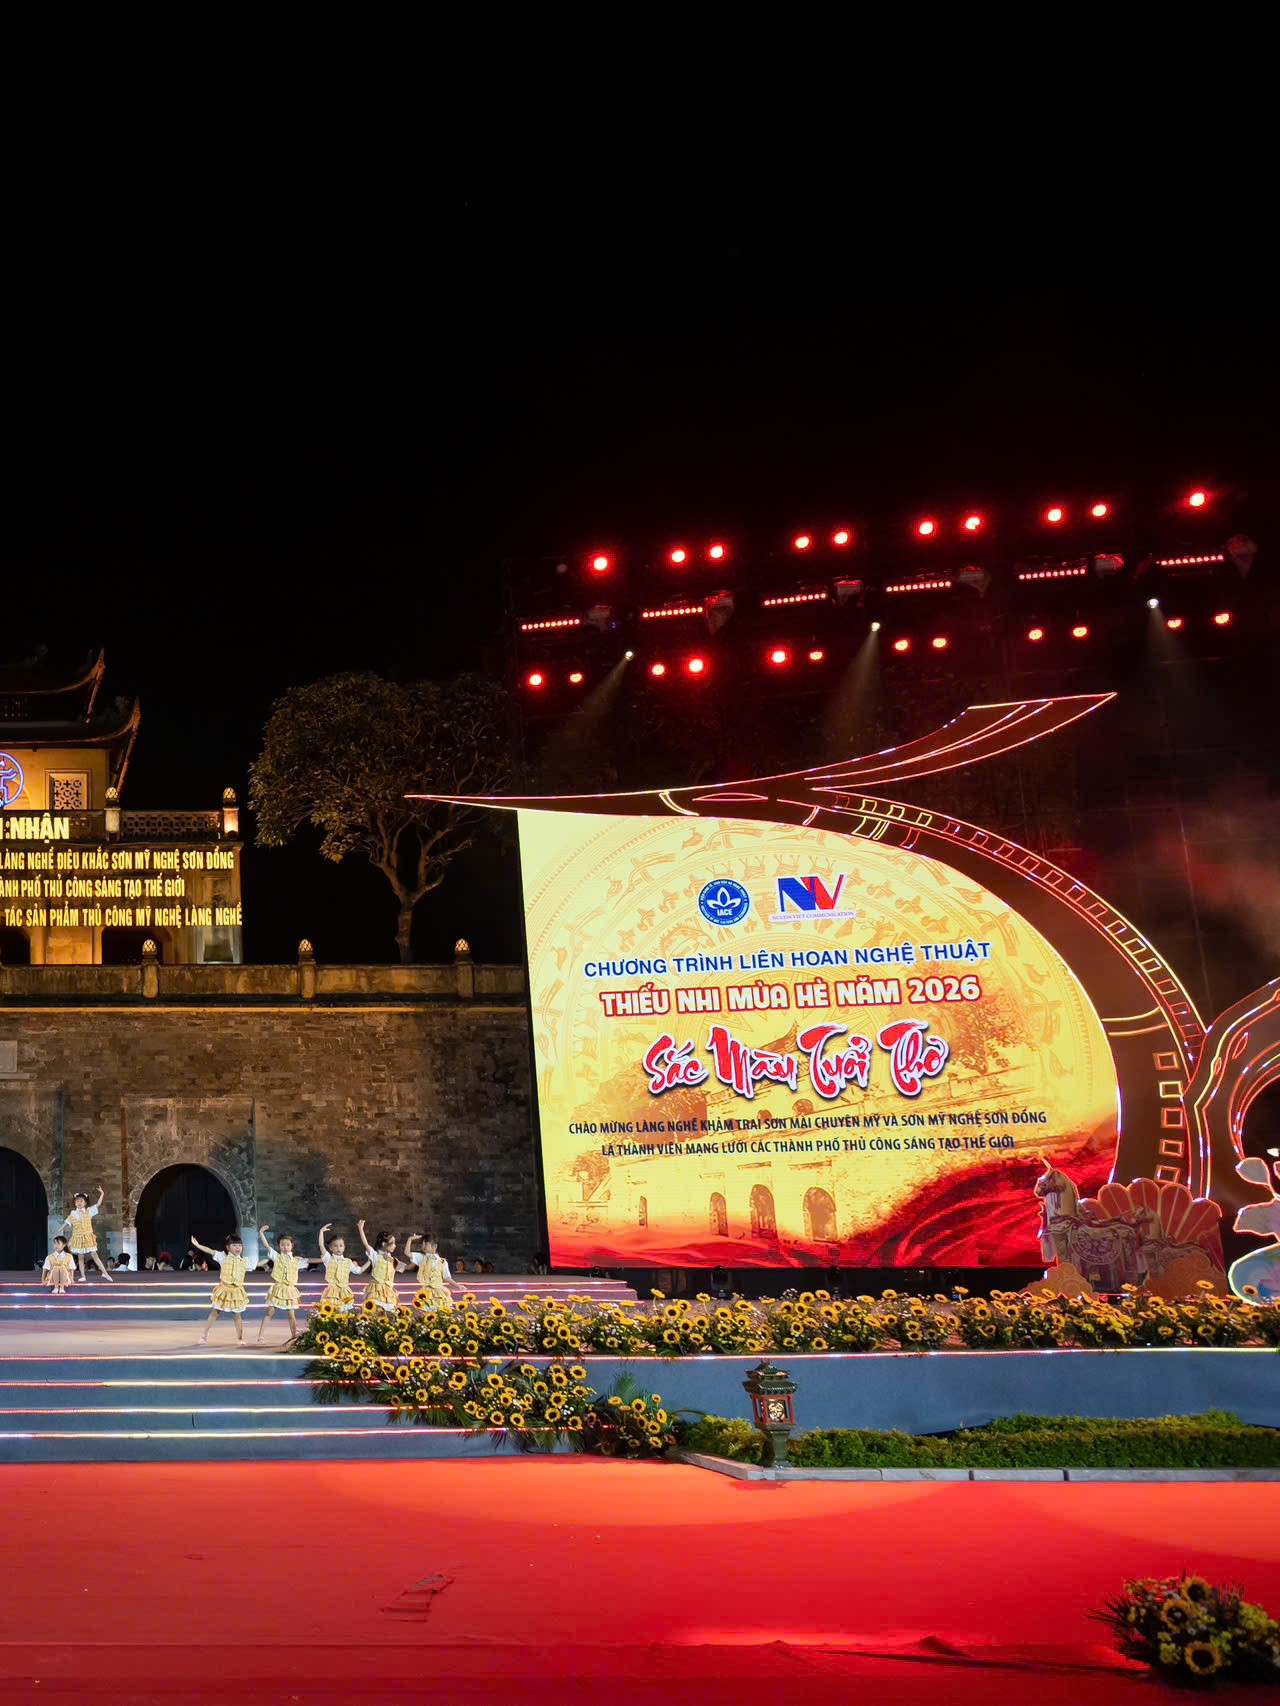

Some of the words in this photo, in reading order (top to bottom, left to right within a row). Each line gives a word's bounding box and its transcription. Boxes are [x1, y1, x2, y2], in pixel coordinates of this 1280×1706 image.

[9, 812, 70, 844] NHẬN
[57, 849, 80, 870] ĐIÊU
[111, 850, 133, 870] SƠN
[135, 849, 151, 870] MỸ
[153, 848, 180, 872] NGHỆ
[182, 850, 204, 870] SƠN
[21, 873, 41, 897] PHỐ
[43, 873, 63, 897] THỦ
[65, 877, 93, 897] CÔNG
[94, 875, 122, 898] SÁNG
[123, 879, 142, 901] TẠO
[144, 872, 163, 898] THẾ
[164, 874, 186, 897] GIỚI
[777, 874, 845, 912] NV
[4, 905, 23, 927] TÁC
[26, 903, 47, 927] SẢN
[49, 900, 79, 927] PHẨM
[82, 902, 102, 927] THỦ
[105, 905, 133, 927] CÔNG
[135, 905, 152, 927] MỸ
[154, 905, 182, 929] NGHỆ
[184, 905, 213, 927] LÀNG
[716, 908, 733, 916] IACE
[584, 958, 667, 977] CHƯƠNG
[672, 953, 733, 973] TRÌNH
[739, 950, 784, 969] LIÊN
[791, 949, 848, 967] HOAN
[855, 942, 915, 965] NGHỆ
[920, 939, 991, 962] THUẬT
[599, 982, 670, 1016] THIẾU
[675, 987, 722, 1014] NHI
[726, 980, 789, 1013] MÙA
[794, 977, 830, 1009] HÈ
[835, 975, 902, 1007] NĂM
[906, 975, 981, 1004] 2026
[569, 1120, 597, 1134] CHÀO
[600, 1120, 634, 1134] MỪNG
[636, 1119, 665, 1133] LÀNG
[700, 1116, 734, 1131] KHẢM
[737, 1118, 761, 1130] TRAI
[764, 1117, 787, 1129] SƠN
[789, 1115, 812, 1129] MÀI
[815, 1114, 860, 1128] CHUYÊN
[863, 1113, 881, 1127] MỸ
[882, 1113, 899, 1126] VÀ
[901, 1113, 925, 1126] SƠN
[928, 1112, 946, 1126] MỸ
[949, 1110, 981, 1128] NGHỆ
[985, 1112, 1009, 1124] SƠN
[602, 1142, 615, 1156] LÀ
[616, 1142, 655, 1156] THÀNH
[657, 1141, 683, 1155] VIÊN
[685, 1142, 719, 1157] MẠNG
[721, 1140, 747, 1154] LƯỚI
[750, 1139, 771, 1153] CÁC
[773, 1138, 813, 1152] THÀNH
[816, 1136, 840, 1151] PHỐ
[842, 1135, 866, 1151] THỦ
[869, 1136, 901, 1150] CÔNG
[904, 1136, 936, 1150] SÁNG
[937, 1137, 961, 1152] TẠO
[962, 1133, 985, 1149] THẾ
[989, 1135, 1015, 1149] GIỚI
